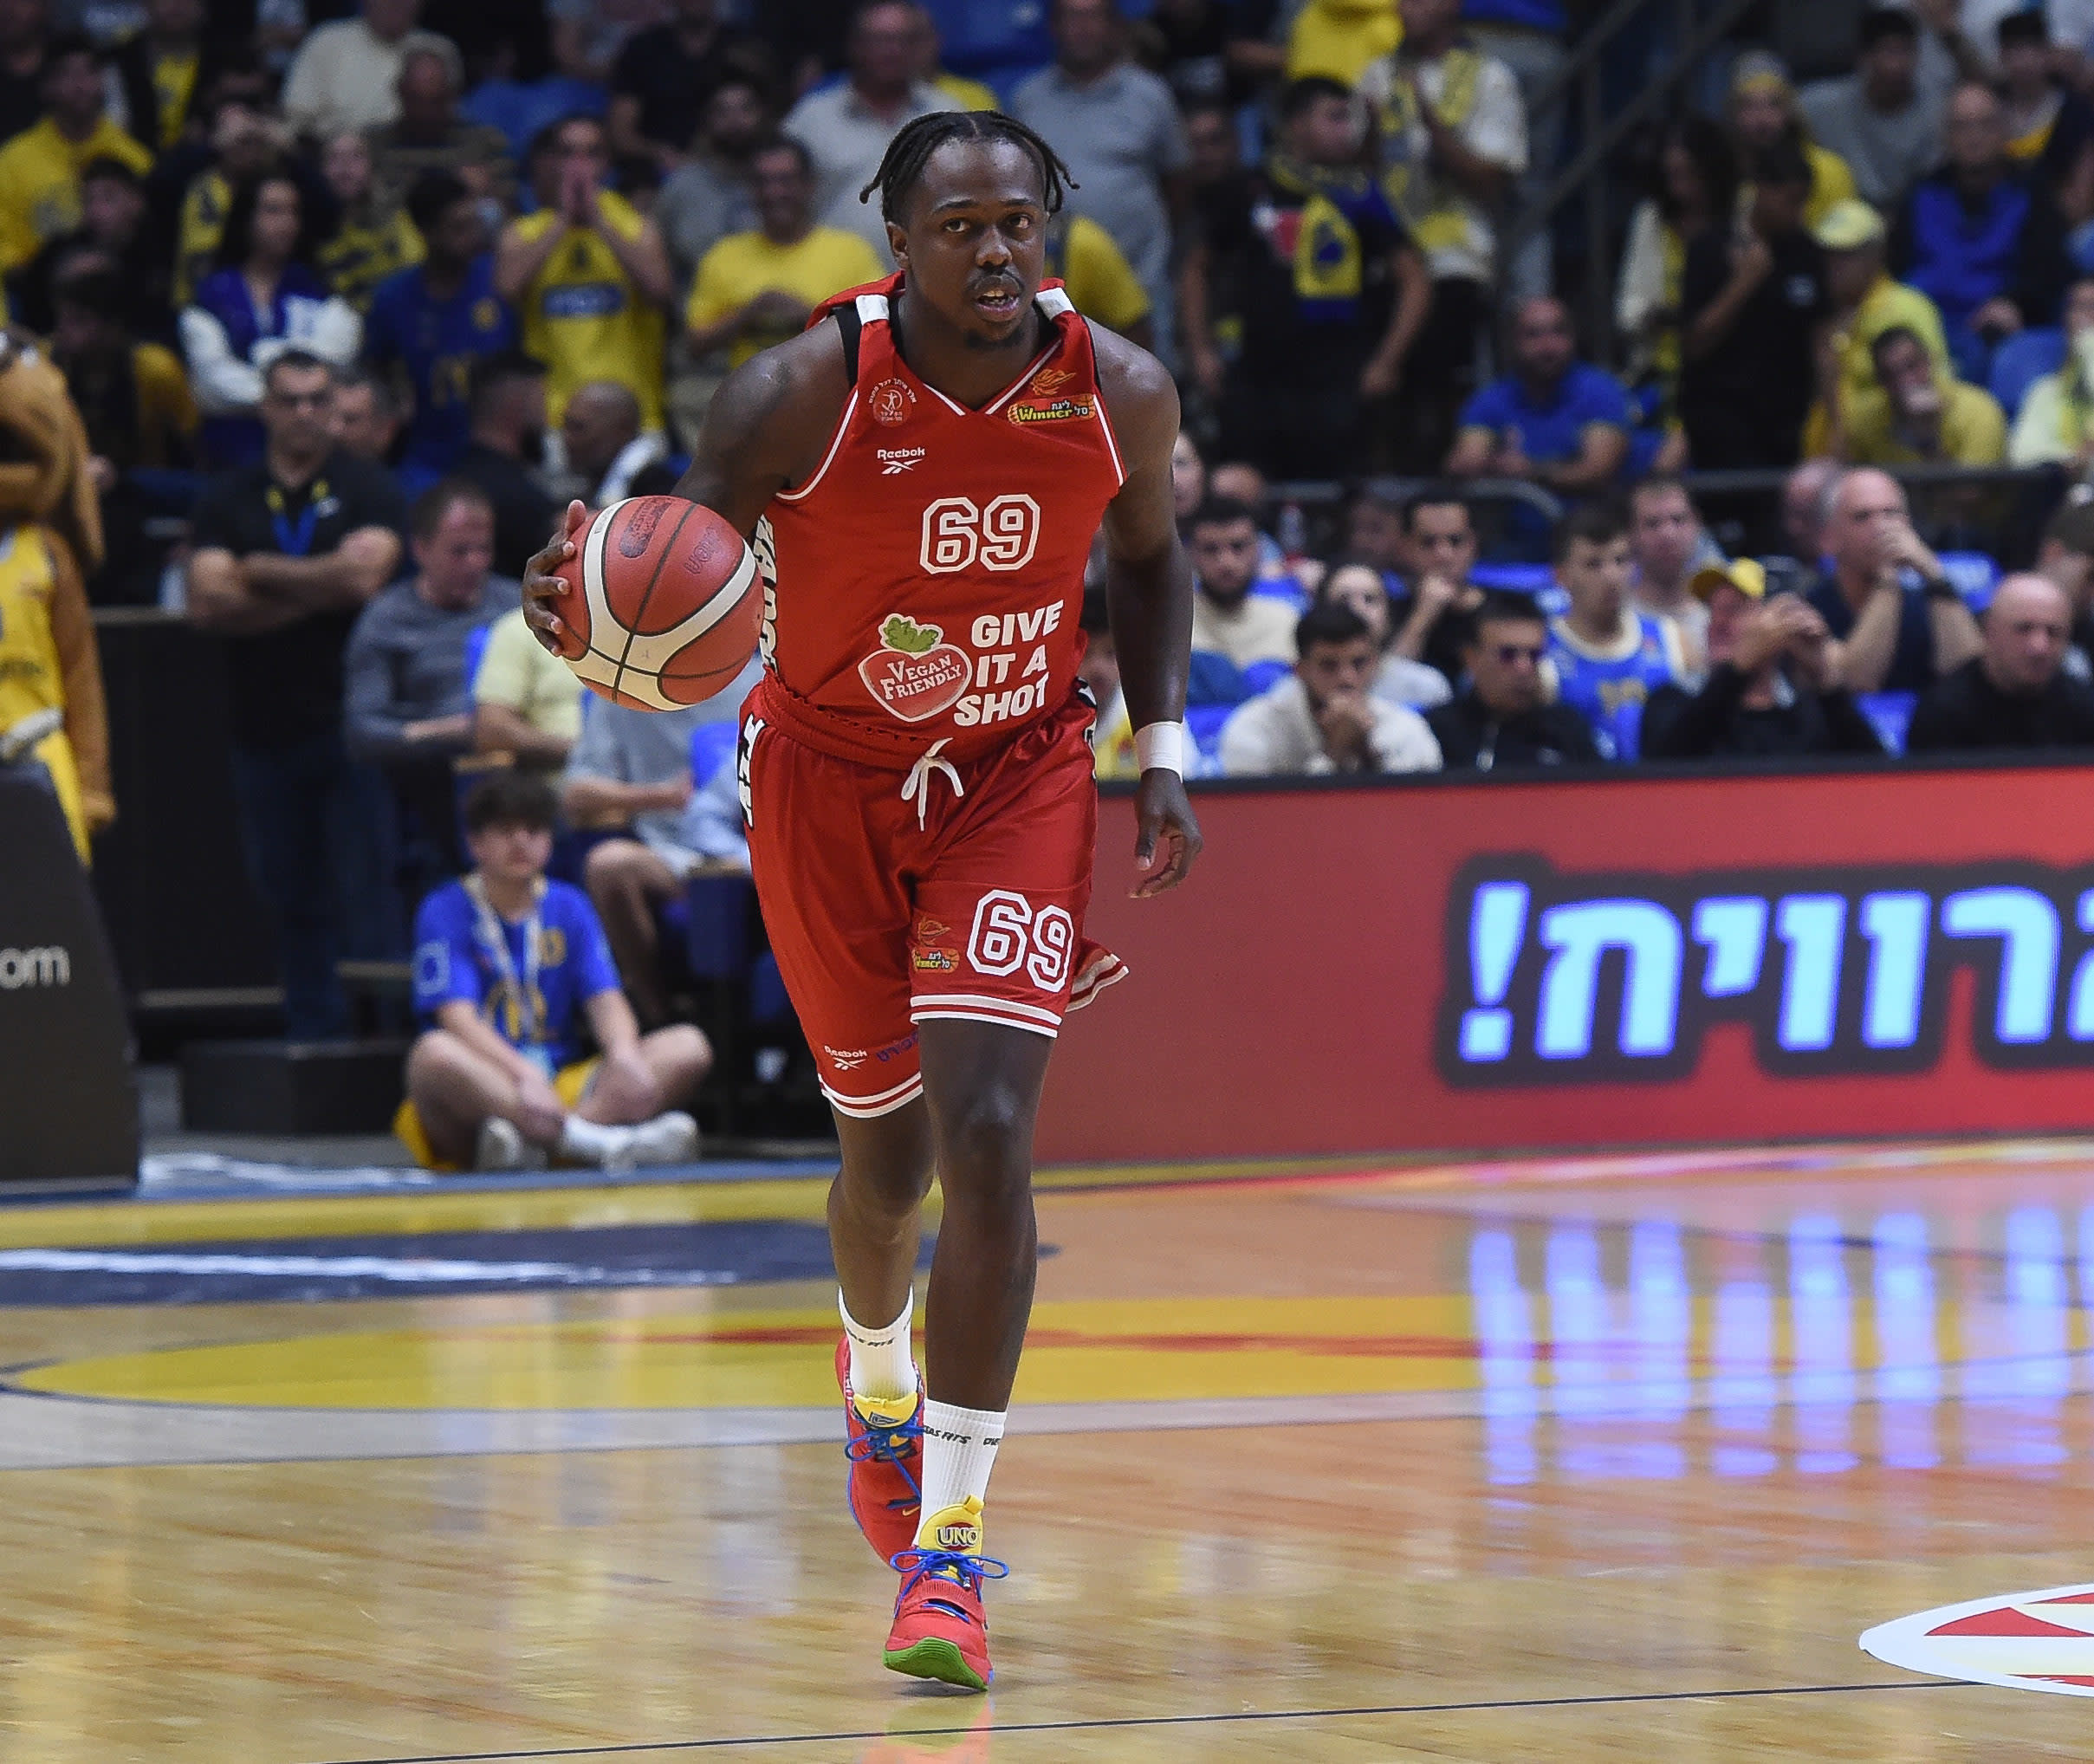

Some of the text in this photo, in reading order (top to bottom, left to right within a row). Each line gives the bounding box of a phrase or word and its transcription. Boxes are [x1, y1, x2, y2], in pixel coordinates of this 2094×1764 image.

[1018, 407, 1073, 421] Winner
[1051, 399, 1071, 411] ליגת
[1073, 405, 1088, 416] סל
[877, 446, 925, 460] Reebok
[919, 494, 1041, 574] 69
[970, 600, 1064, 648] GIVE
[880, 664, 962, 701] FRIENDLY
[887, 654, 952, 683] VEGAN
[976, 644, 1047, 688] IT A
[954, 671, 1050, 727] SHOT
[967, 889, 1074, 993] 69
[1459, 879, 2094, 1062] רוויח!
[936, 1527, 979, 1547] UNO
